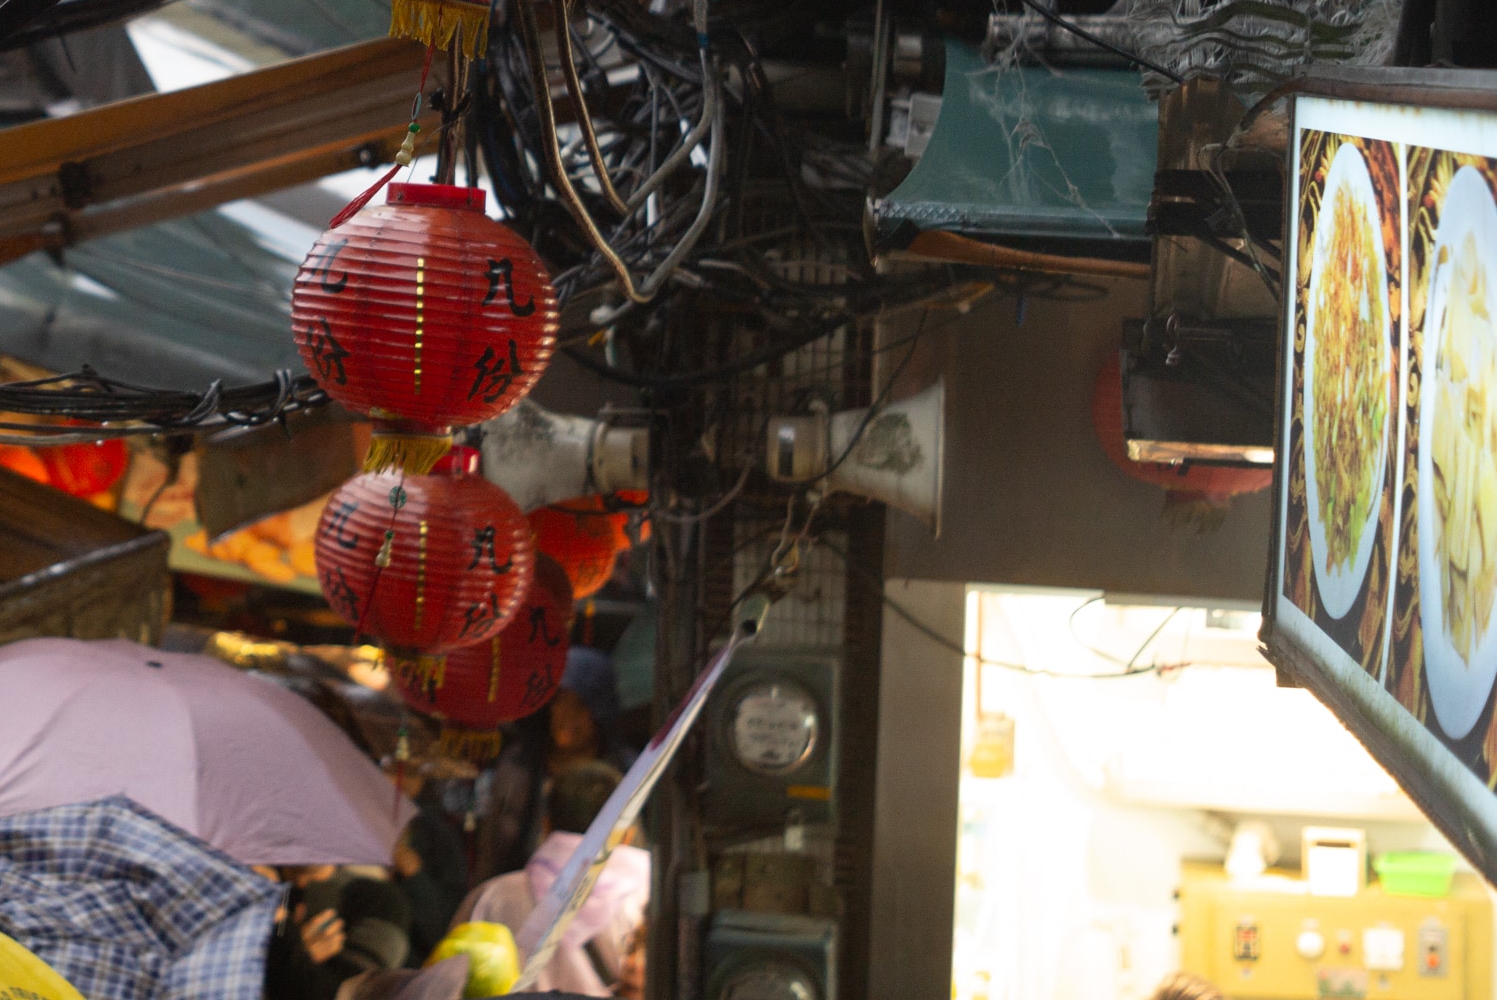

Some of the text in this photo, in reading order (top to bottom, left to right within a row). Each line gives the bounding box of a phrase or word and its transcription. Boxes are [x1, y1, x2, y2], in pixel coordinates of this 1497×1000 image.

[303, 238, 350, 385] 九份
[467, 258, 536, 402] 九份
[324, 501, 360, 620] 九份
[458, 526, 513, 639] 九份
[522, 606, 560, 706] 九份
